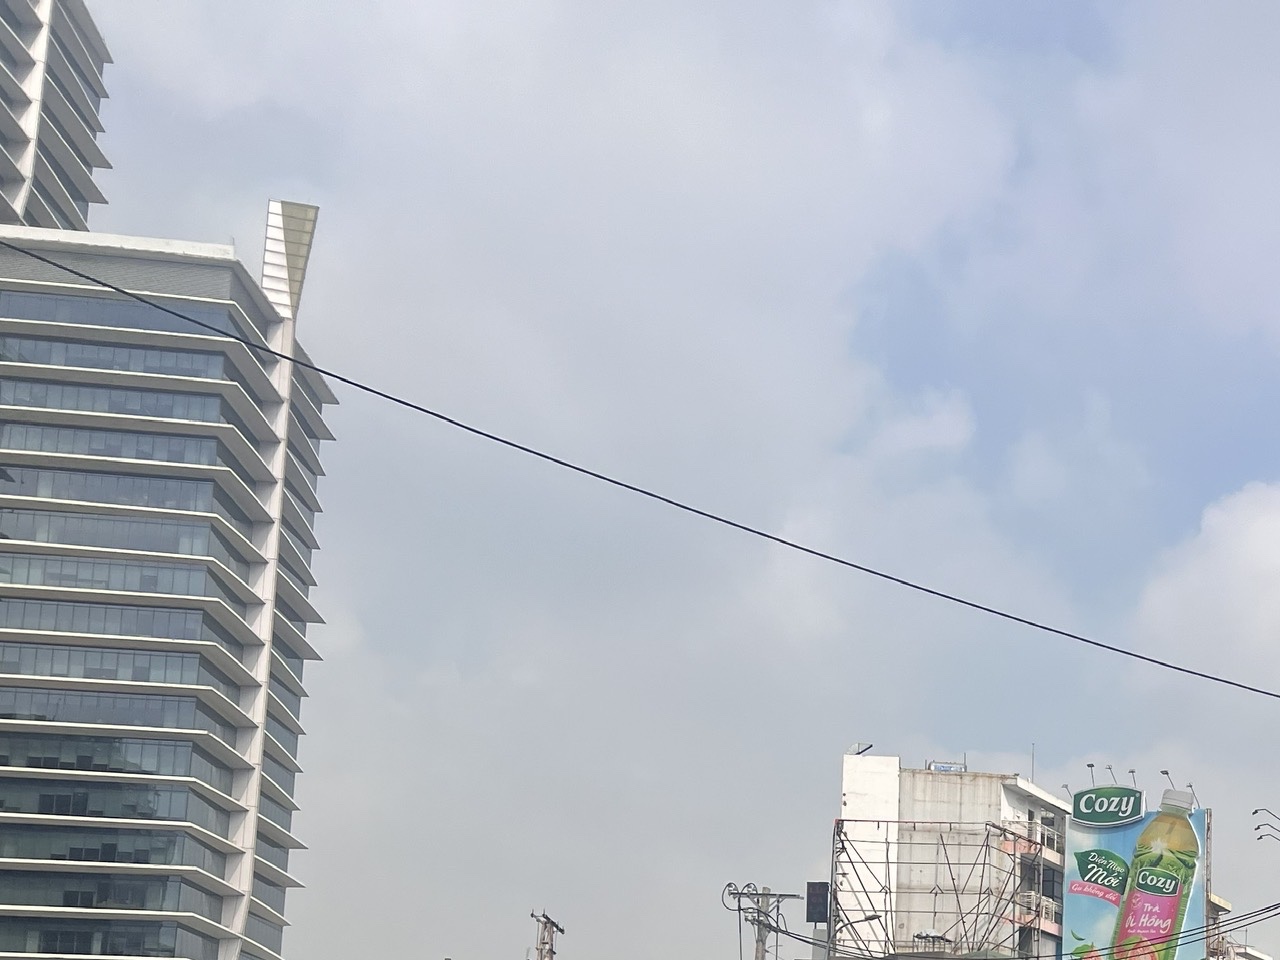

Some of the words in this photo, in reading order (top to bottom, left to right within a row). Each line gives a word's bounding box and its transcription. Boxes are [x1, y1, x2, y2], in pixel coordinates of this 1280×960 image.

[1080, 793, 1135, 817] Cozy
[1088, 852, 1107, 865] Diện
[1084, 864, 1122, 887] Mới
[1139, 871, 1176, 892] Cozy
